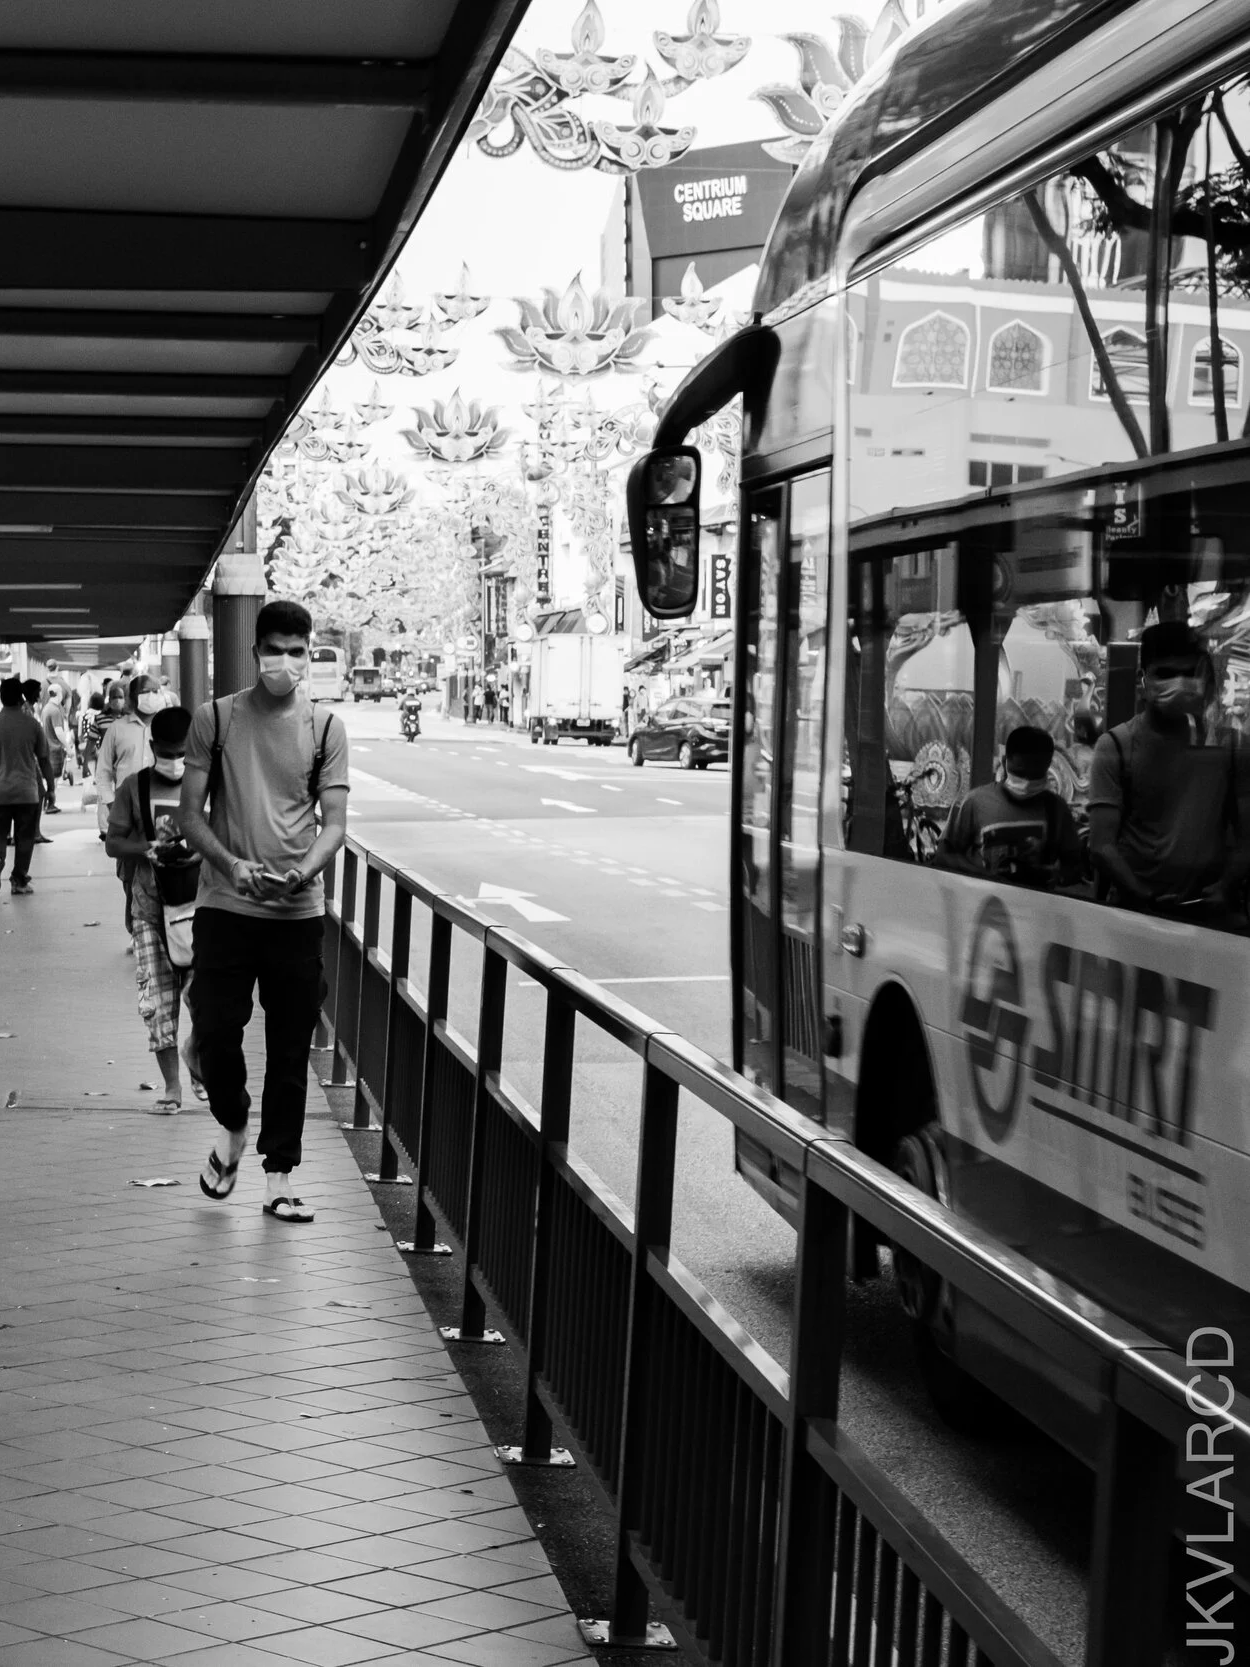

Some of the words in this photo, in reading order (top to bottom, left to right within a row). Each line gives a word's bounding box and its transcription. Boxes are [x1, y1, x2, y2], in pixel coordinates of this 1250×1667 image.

[674, 175, 747, 203] CENTRIUM
[683, 196, 743, 222] SQUARE
[1032, 941, 1218, 1148] SMRT
